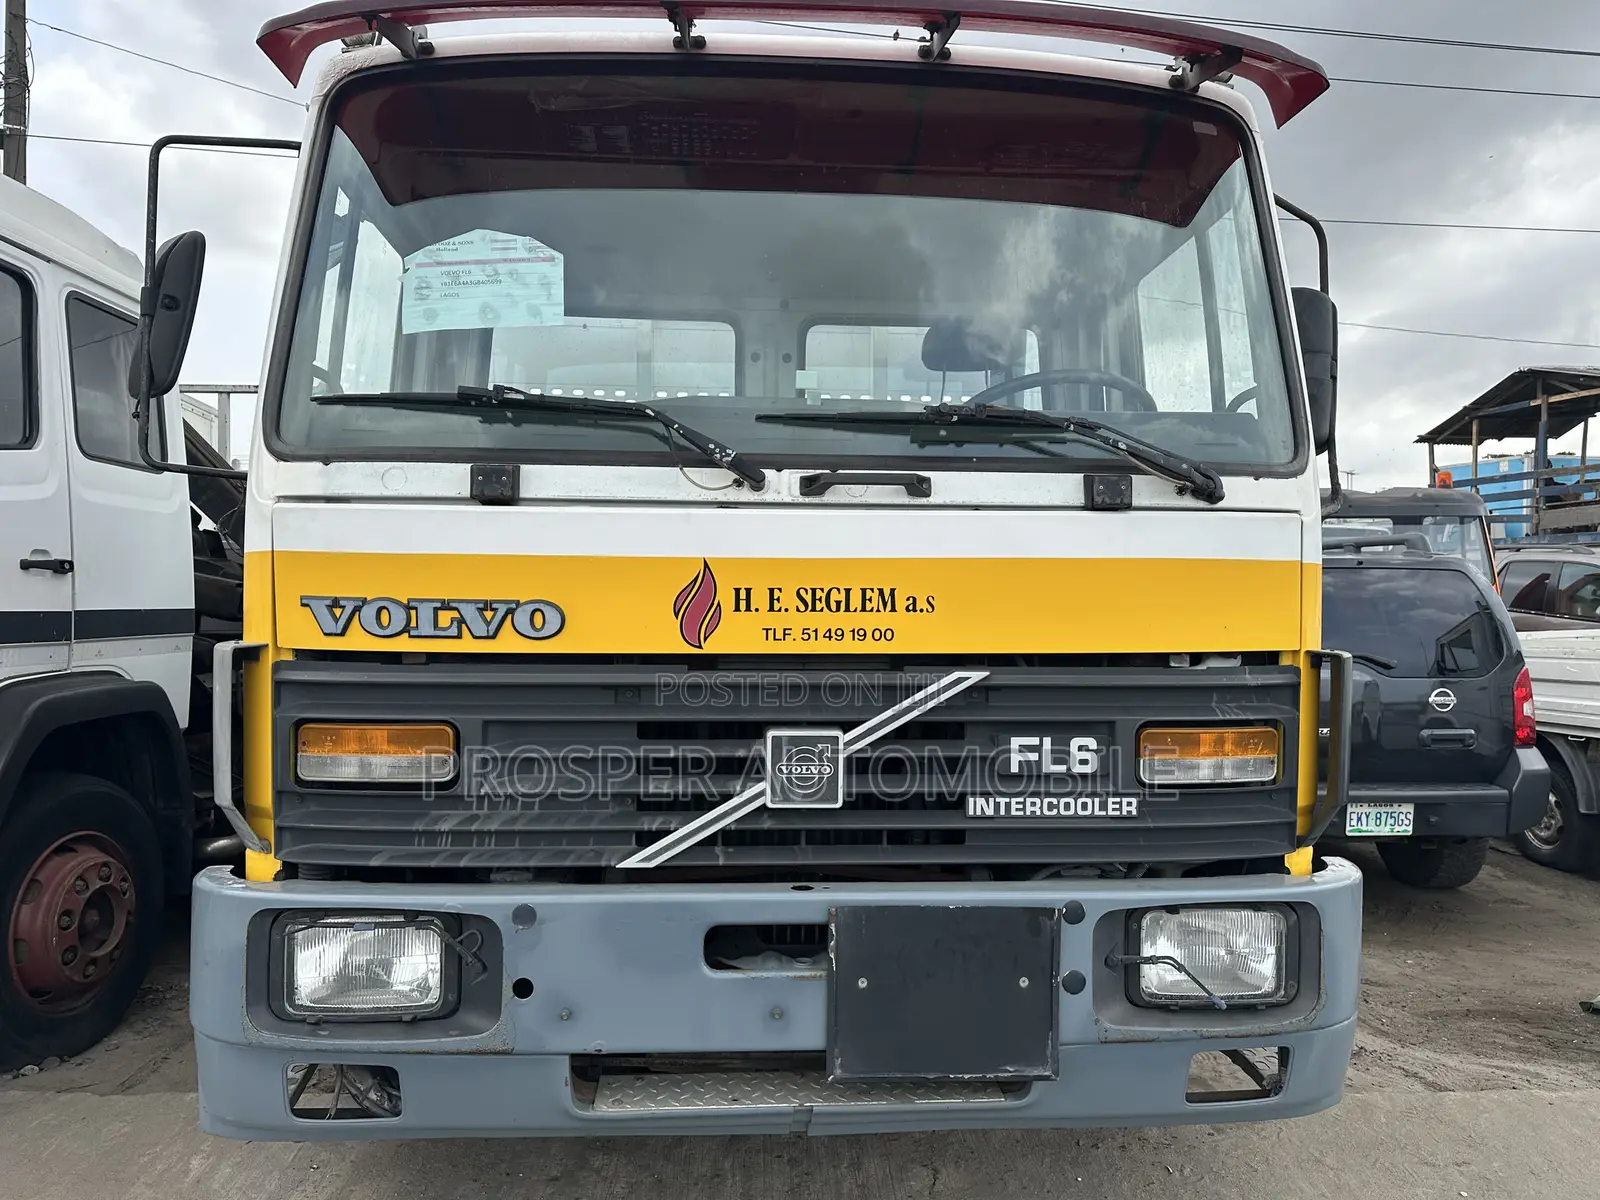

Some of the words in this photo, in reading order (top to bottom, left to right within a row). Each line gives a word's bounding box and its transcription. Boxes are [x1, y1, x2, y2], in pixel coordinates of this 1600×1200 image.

[732, 587, 760, 613] H.
[767, 587, 789, 613] E.
[795, 586, 898, 613] SEGLEM
[904, 594, 936, 613] a.s
[300, 595, 566, 641] VOLVO
[762, 627, 796, 642] TLF.
[800, 627, 819, 642] 51
[822, 627, 845, 642] 49
[849, 627, 867, 642] 19
[871, 627, 895, 642] 00
[1010, 736, 1098, 773] FL6
[779, 765, 831, 774] VOLVO
[968, 797, 1138, 816] INTERCOOLER
